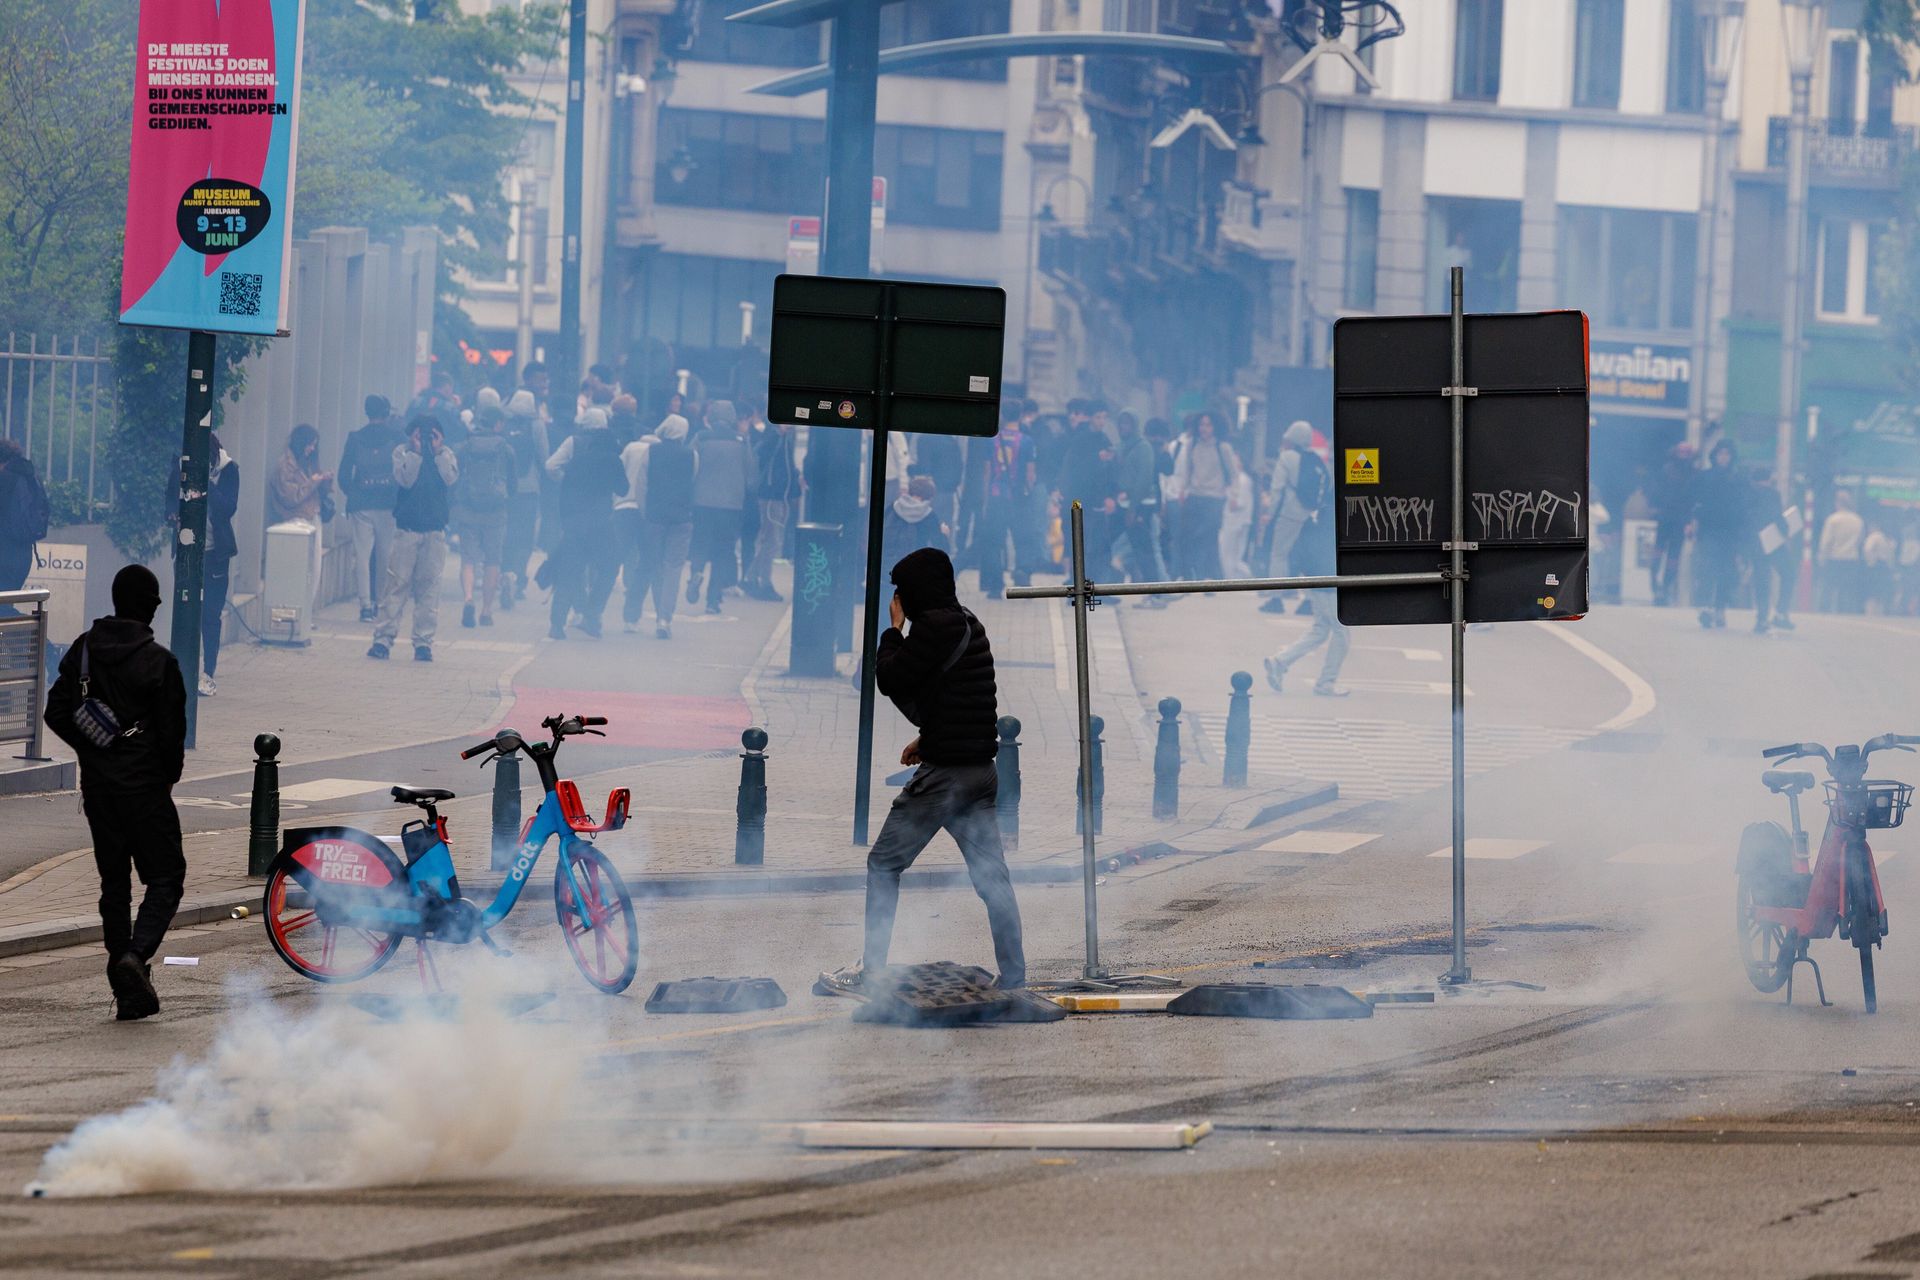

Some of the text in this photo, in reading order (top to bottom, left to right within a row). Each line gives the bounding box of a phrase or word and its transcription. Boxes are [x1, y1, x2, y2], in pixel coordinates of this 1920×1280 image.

[148, 44, 229, 56] DE MEESTE
[148, 58, 269, 71] FESTIVALS DOEN
[148, 73, 279, 86] MENSEN DANSEN.
[148, 88, 268, 100] BIJ ONS KUNNEN
[148, 103, 287, 115] GEMEENSCHAPPEN
[148, 118, 212, 130] GEDIJEN.
[193, 189, 251, 200] MUSEUM
[197, 216, 209, 232] 9
[224, 216, 247, 232] 13
[205, 233, 239, 246] JUNI
[37, 551, 84, 570] plaza
[315, 843, 344, 861] TRY
[512, 841, 539, 881] dott
[321, 861, 367, 882] FREE!
